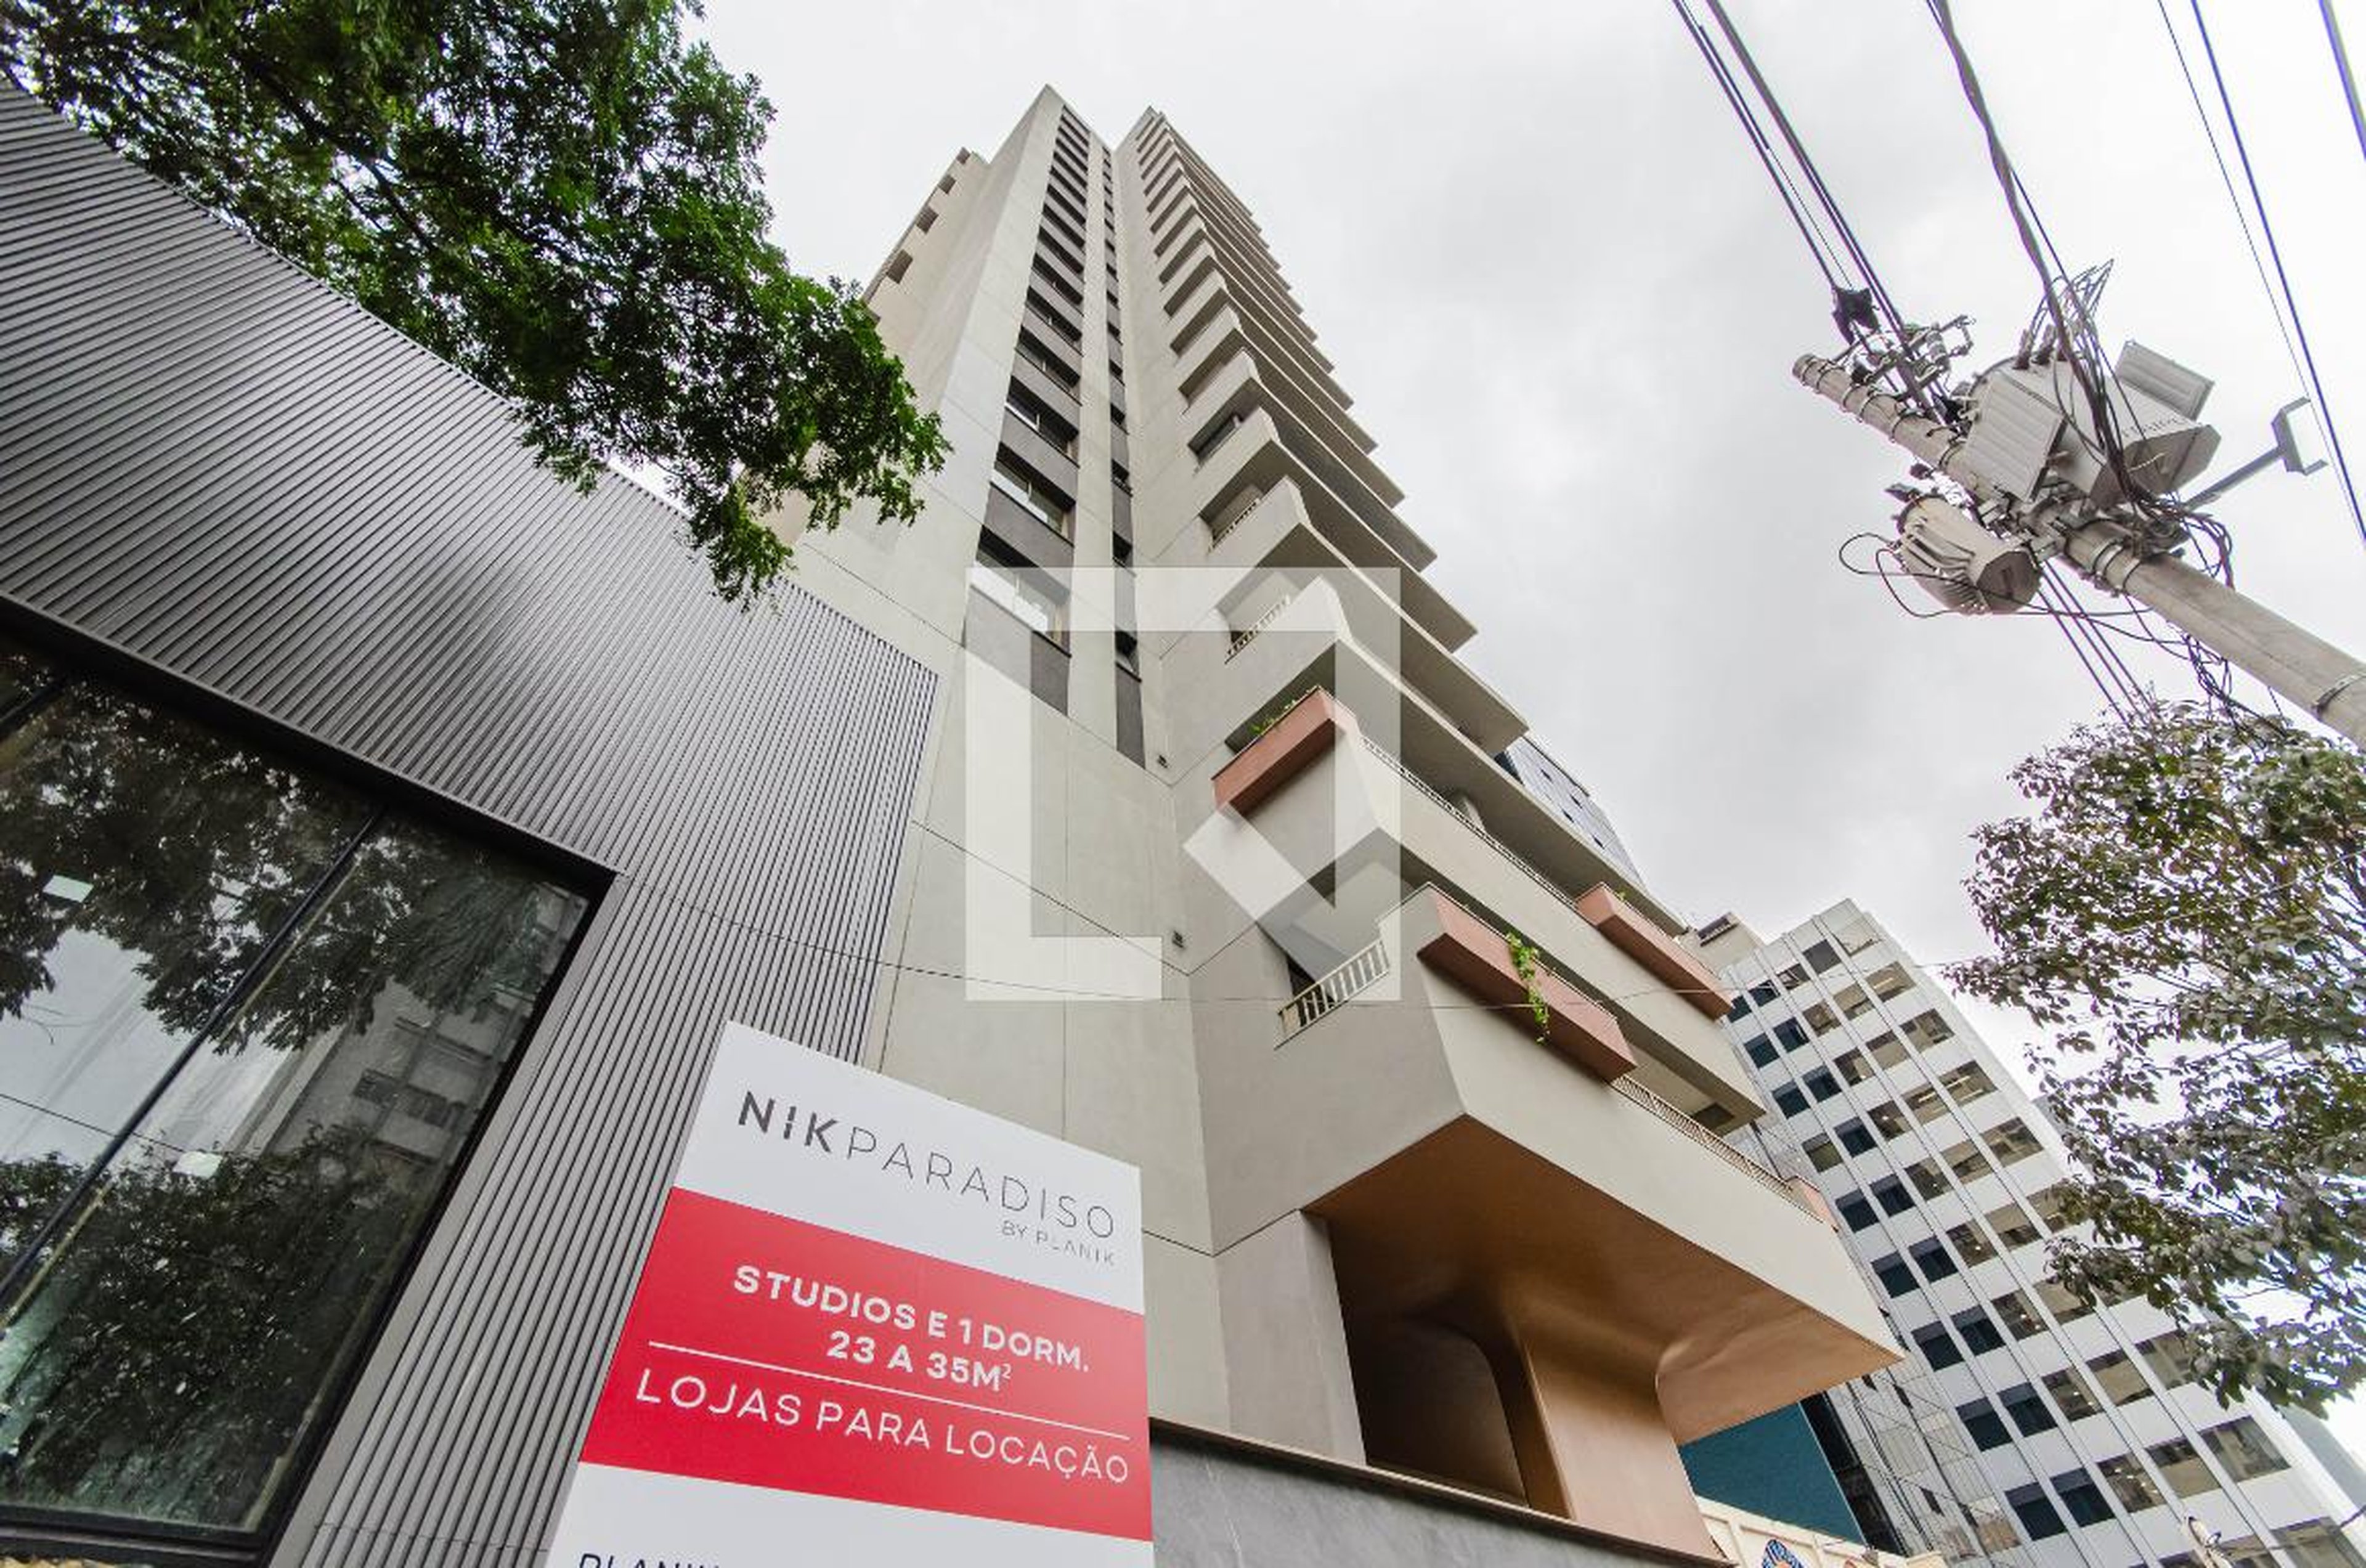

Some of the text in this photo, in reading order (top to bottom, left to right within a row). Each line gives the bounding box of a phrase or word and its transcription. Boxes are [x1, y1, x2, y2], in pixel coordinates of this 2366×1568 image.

[1002, 1221, 1027, 1237] BY
[734, 1265, 1089, 1372] STUDIOS E 1 DORM.
[826, 1330, 876, 1363] 23
[887, 1344, 913, 1373] A
[636, 1368, 1129, 1483] LOJAS PARA LOCAÇÃO
